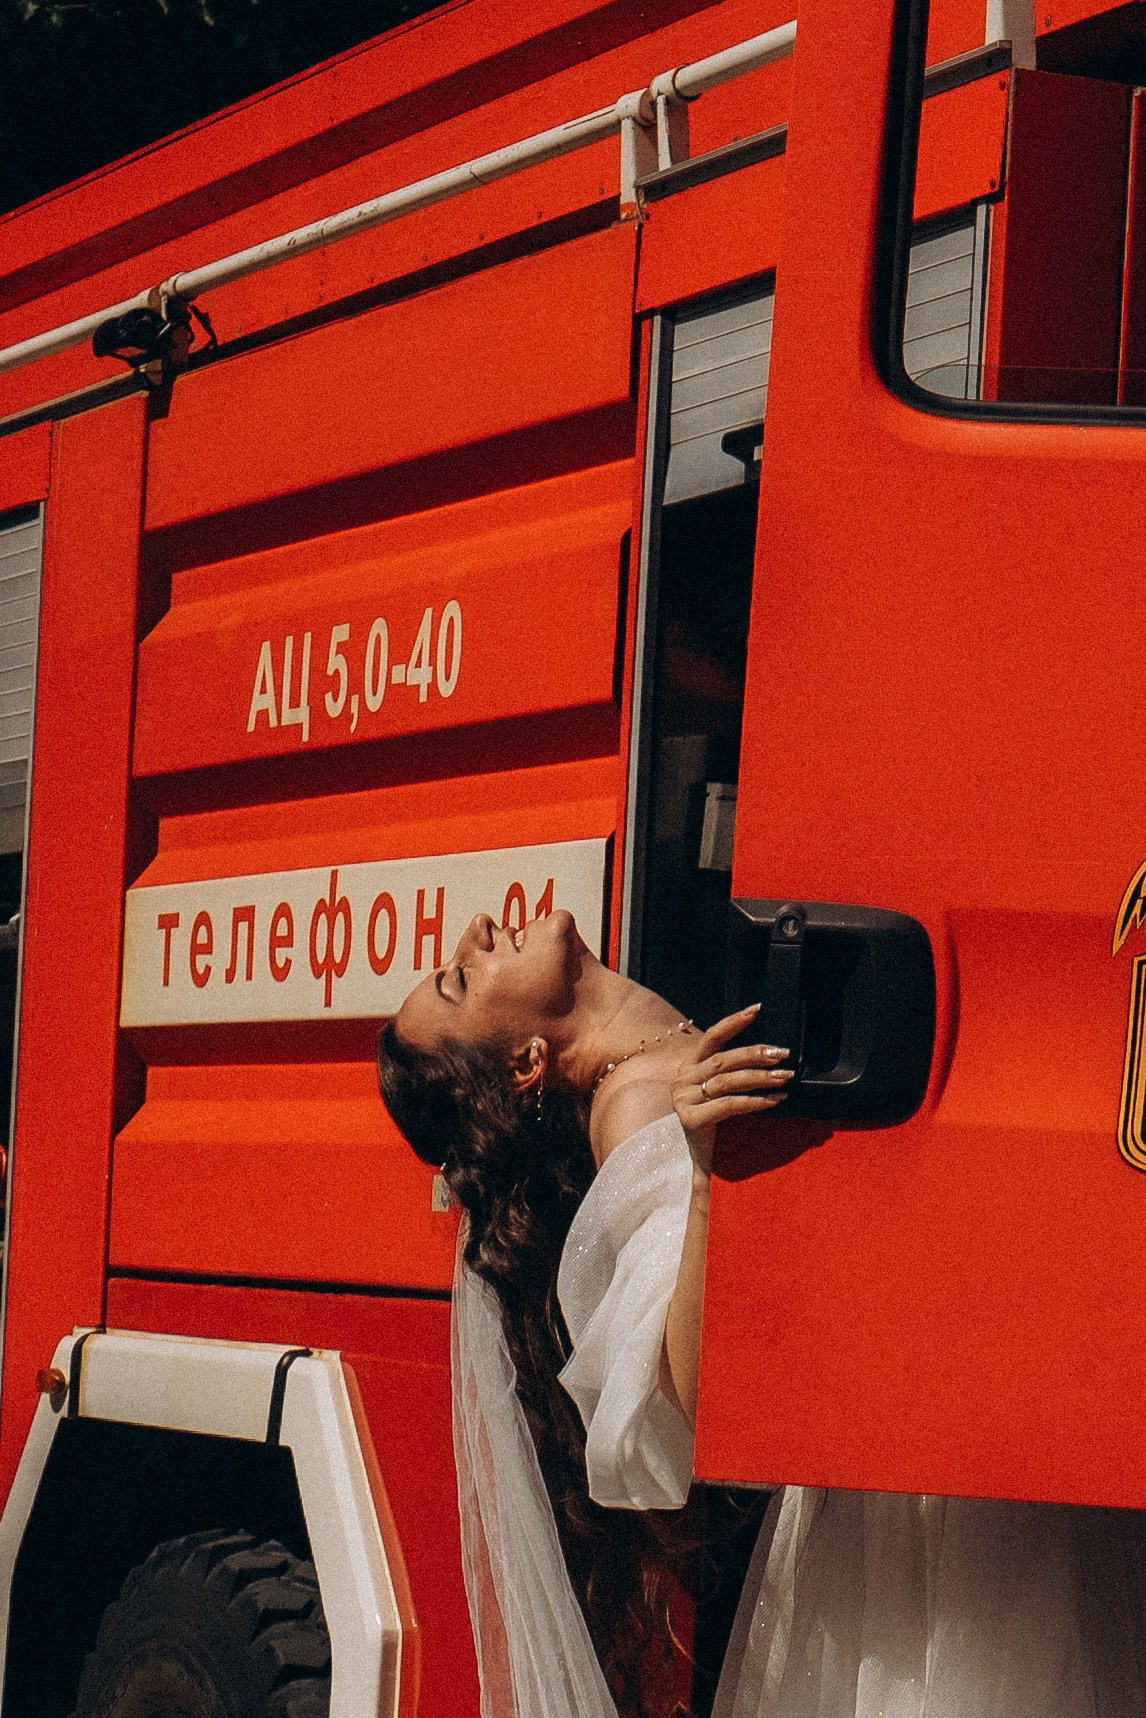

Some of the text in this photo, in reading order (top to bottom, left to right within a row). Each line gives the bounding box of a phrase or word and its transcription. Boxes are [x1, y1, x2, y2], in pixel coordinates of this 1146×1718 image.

[246, 600, 463, 742] АЦ 5,0-40
[156, 869, 446, 1008] телефон
